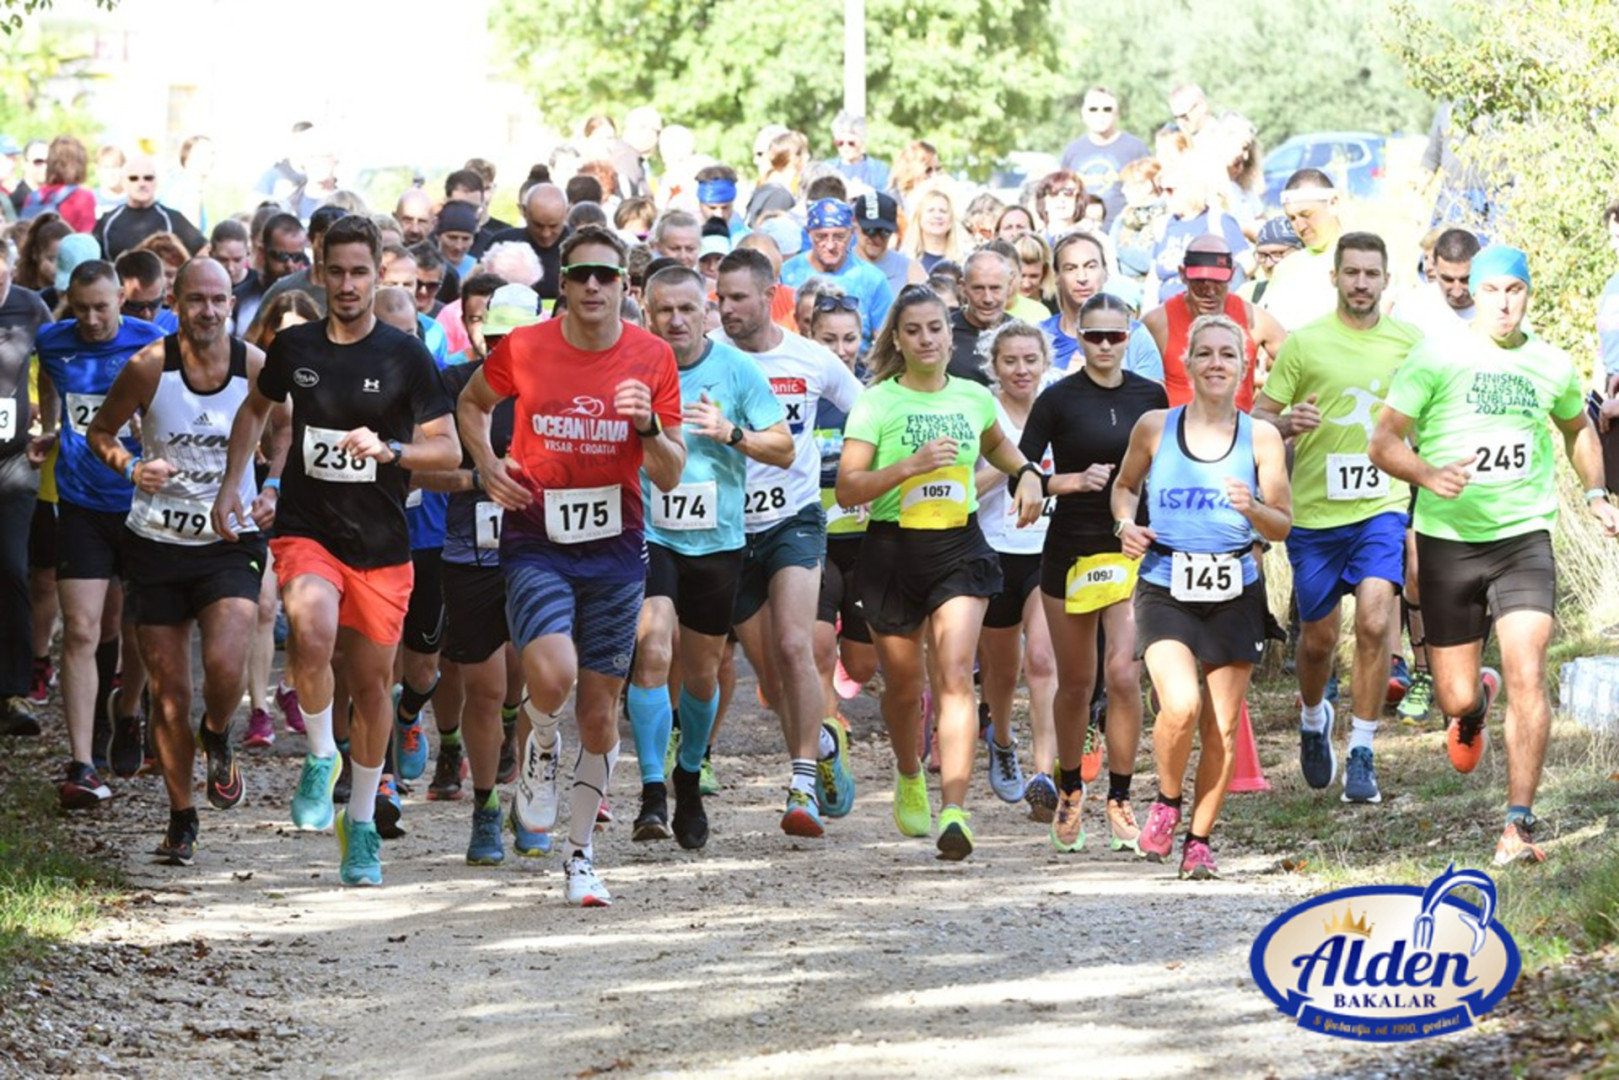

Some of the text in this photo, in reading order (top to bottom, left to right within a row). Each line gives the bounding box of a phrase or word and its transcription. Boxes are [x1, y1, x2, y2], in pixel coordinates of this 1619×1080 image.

[532, 414, 585, 440] OCEAN
[544, 439, 573, 453] VRSAR
[580, 443, 616, 455] CROATIA
[1476, 444, 1526, 472] 245
[1339, 466, 1380, 490] 173
[922, 485, 952, 498] 1057
[559, 500, 609, 531] 175
[662, 495, 706, 519] 174
[162, 509, 207, 536] 179
[1184, 566, 1232, 591] 145
